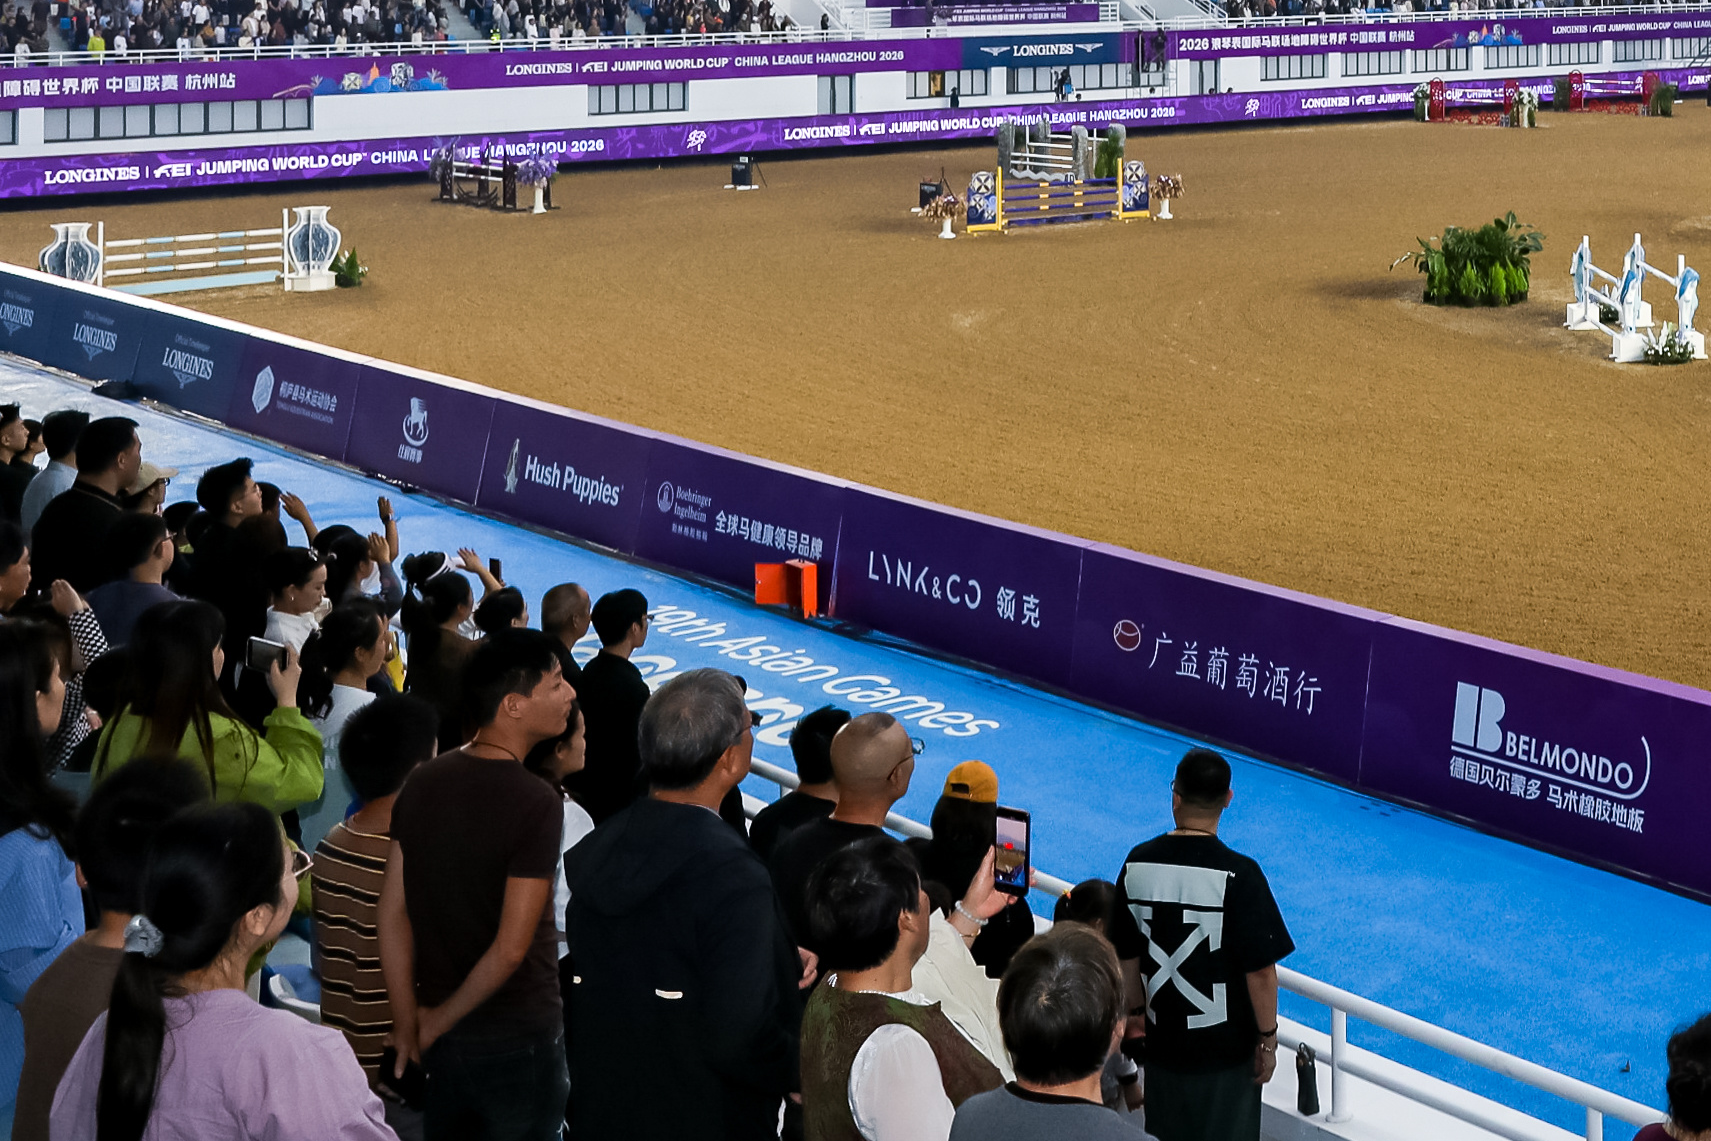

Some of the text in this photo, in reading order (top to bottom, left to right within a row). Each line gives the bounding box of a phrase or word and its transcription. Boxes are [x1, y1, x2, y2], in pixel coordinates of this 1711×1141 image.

[1179, 37, 1209, 51] 2026
[1350, 31, 1387, 44] 中国联赛
[1552, 24, 1588, 35] LONGINES
[1608, 22, 1635, 32] JUMPING
[1636, 22, 1657, 31] WORLD
[1658, 21, 1670, 30] CUP
[1673, 21, 1692, 30] CHINA
[505, 62, 572, 76] LONGINES
[611, 58, 662, 72] JUMPING
[664, 57, 705, 70] WORLD
[706, 57, 729, 69] CUP
[734, 55, 769, 68] CHINA
[772, 53, 814, 66] LEAGUE
[816, 51, 877, 64] HANGZHOU
[880, 50, 905, 61] 2026
[1013, 43, 1074, 57] LONGINES
[106, 73, 179, 93] 中国联赛
[185, 72, 236, 91] 杭州站
[1301, 95, 1350, 109] LONGINES
[783, 125, 851, 141] LONGINES
[888, 120, 939, 135] JUMPING
[940, 117, 981, 131] WORLD
[982, 116, 1005, 129] CUP
[1046, 110, 1087, 125] LEAGUE
[1089, 108, 1148, 122] HANGZHOU
[1150, 105, 1175, 118] 2026
[44, 166, 140, 185] LONGINES
[196, 158, 270, 175] JUMPING
[272, 154, 329, 173] WORLD
[331, 152, 363, 167] CUP
[371, 149, 419, 164] CHINA
[571, 139, 605, 153] 2026
[73, 323, 118, 352] LONGINES
[162, 347, 214, 380] LONGINES
[525, 454, 620, 507] Hush Puppies
[676, 485, 712, 508] Boehringer
[674, 502, 707, 523] Ingelheim
[715, 510, 823, 561] 全球马健康领导品牌
[996, 586, 1041, 629] 领克
[651, 604, 727, 648] 19th
[718, 635, 840, 683] Asian
[821, 674, 1000, 738] Games
[1148, 631, 1322, 716] 广益葡萄酒行
[1504, 730, 1634, 789] BELMONDO
[1449, 755, 1645, 834] 德国贝尔蒙多 马术橡胶地板
